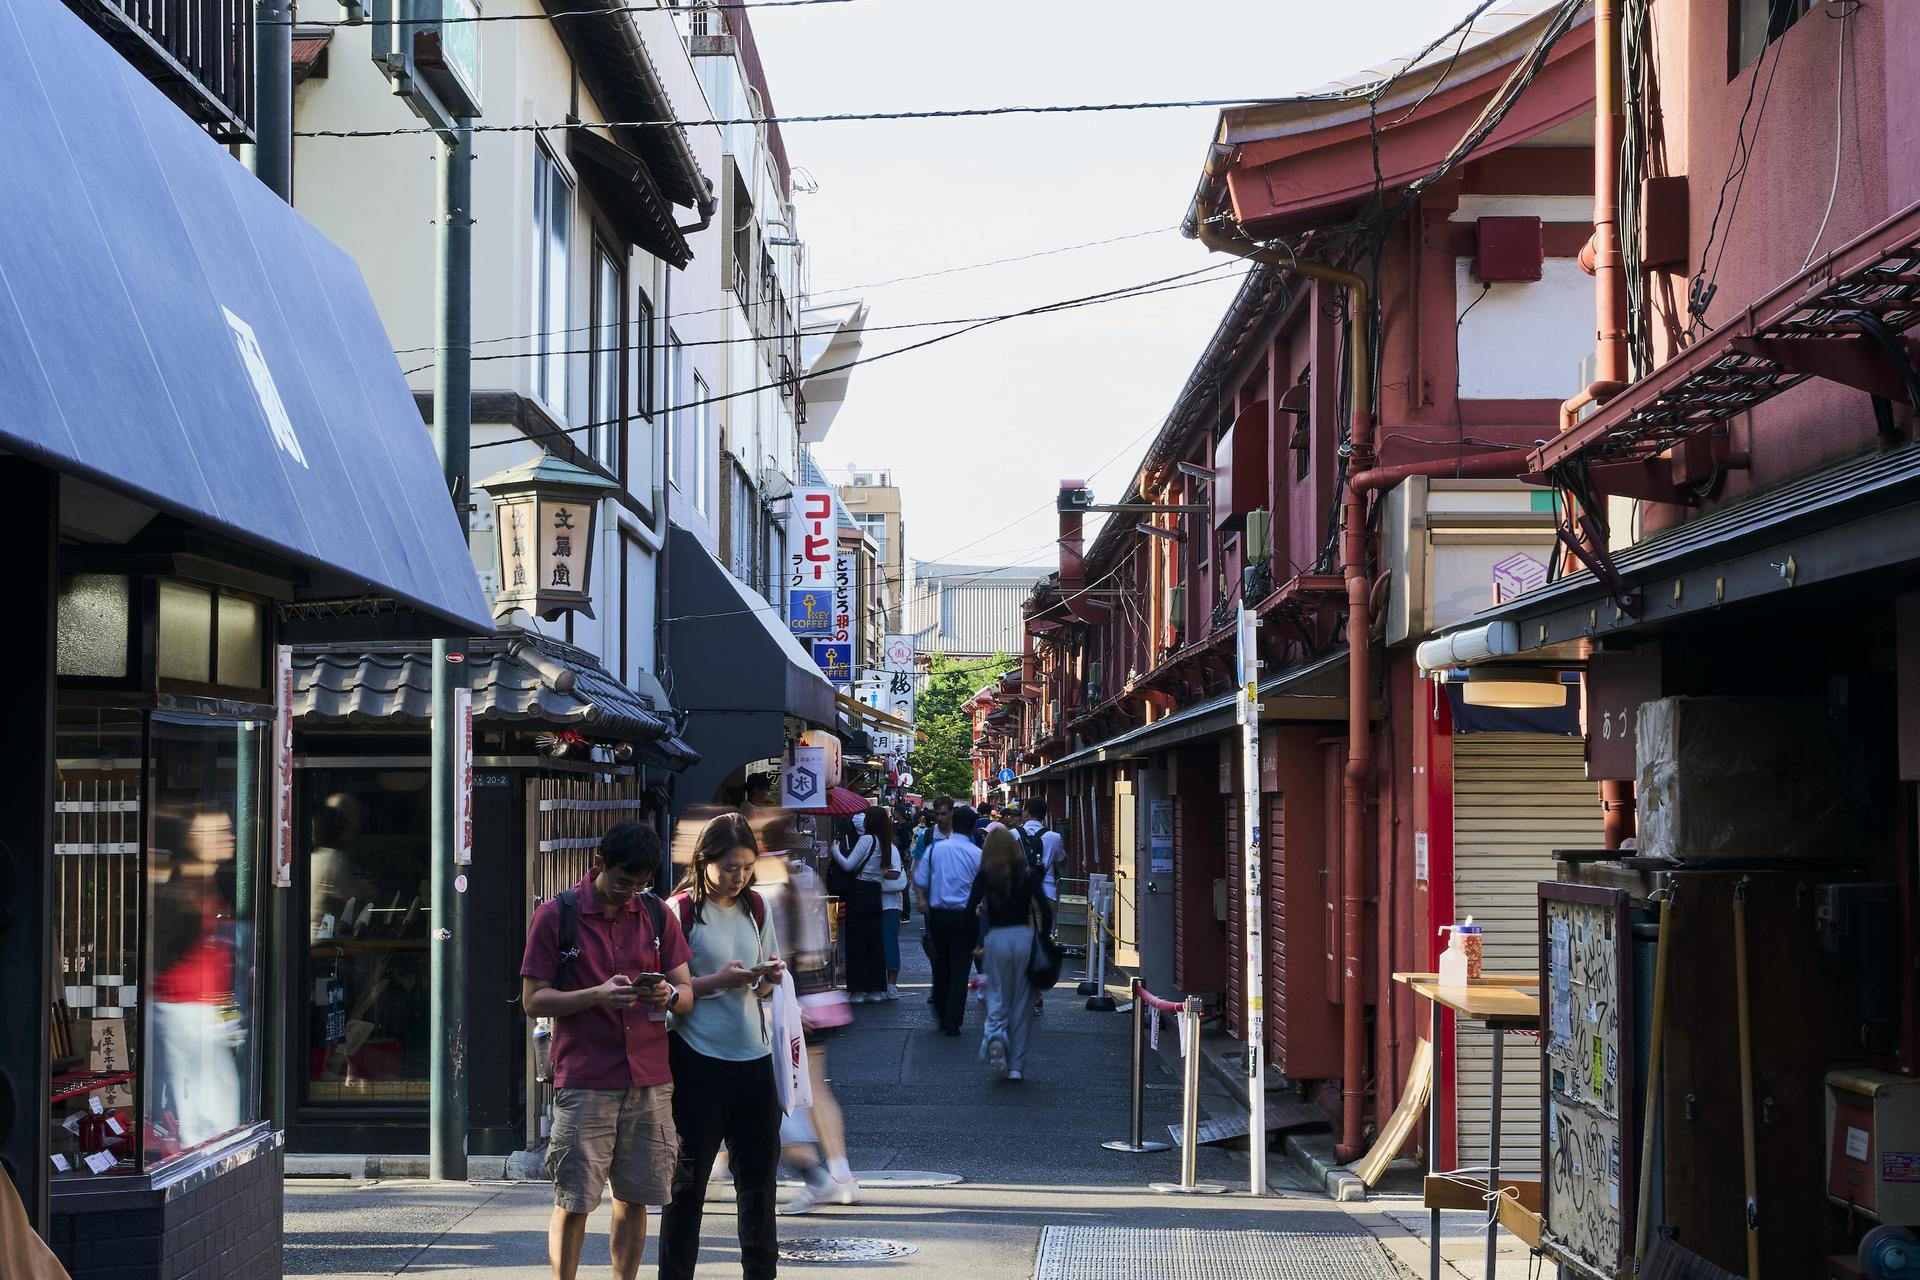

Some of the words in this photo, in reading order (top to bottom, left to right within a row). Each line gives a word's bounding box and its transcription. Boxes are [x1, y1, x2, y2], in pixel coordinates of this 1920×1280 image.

[805, 494, 831, 580] コーヒー
[791, 554, 803, 587] ラーク
[791, 619, 829, 629] COFFEE
[822, 669, 849, 677] OFFEE
[486, 775, 506, 784] 20-2
